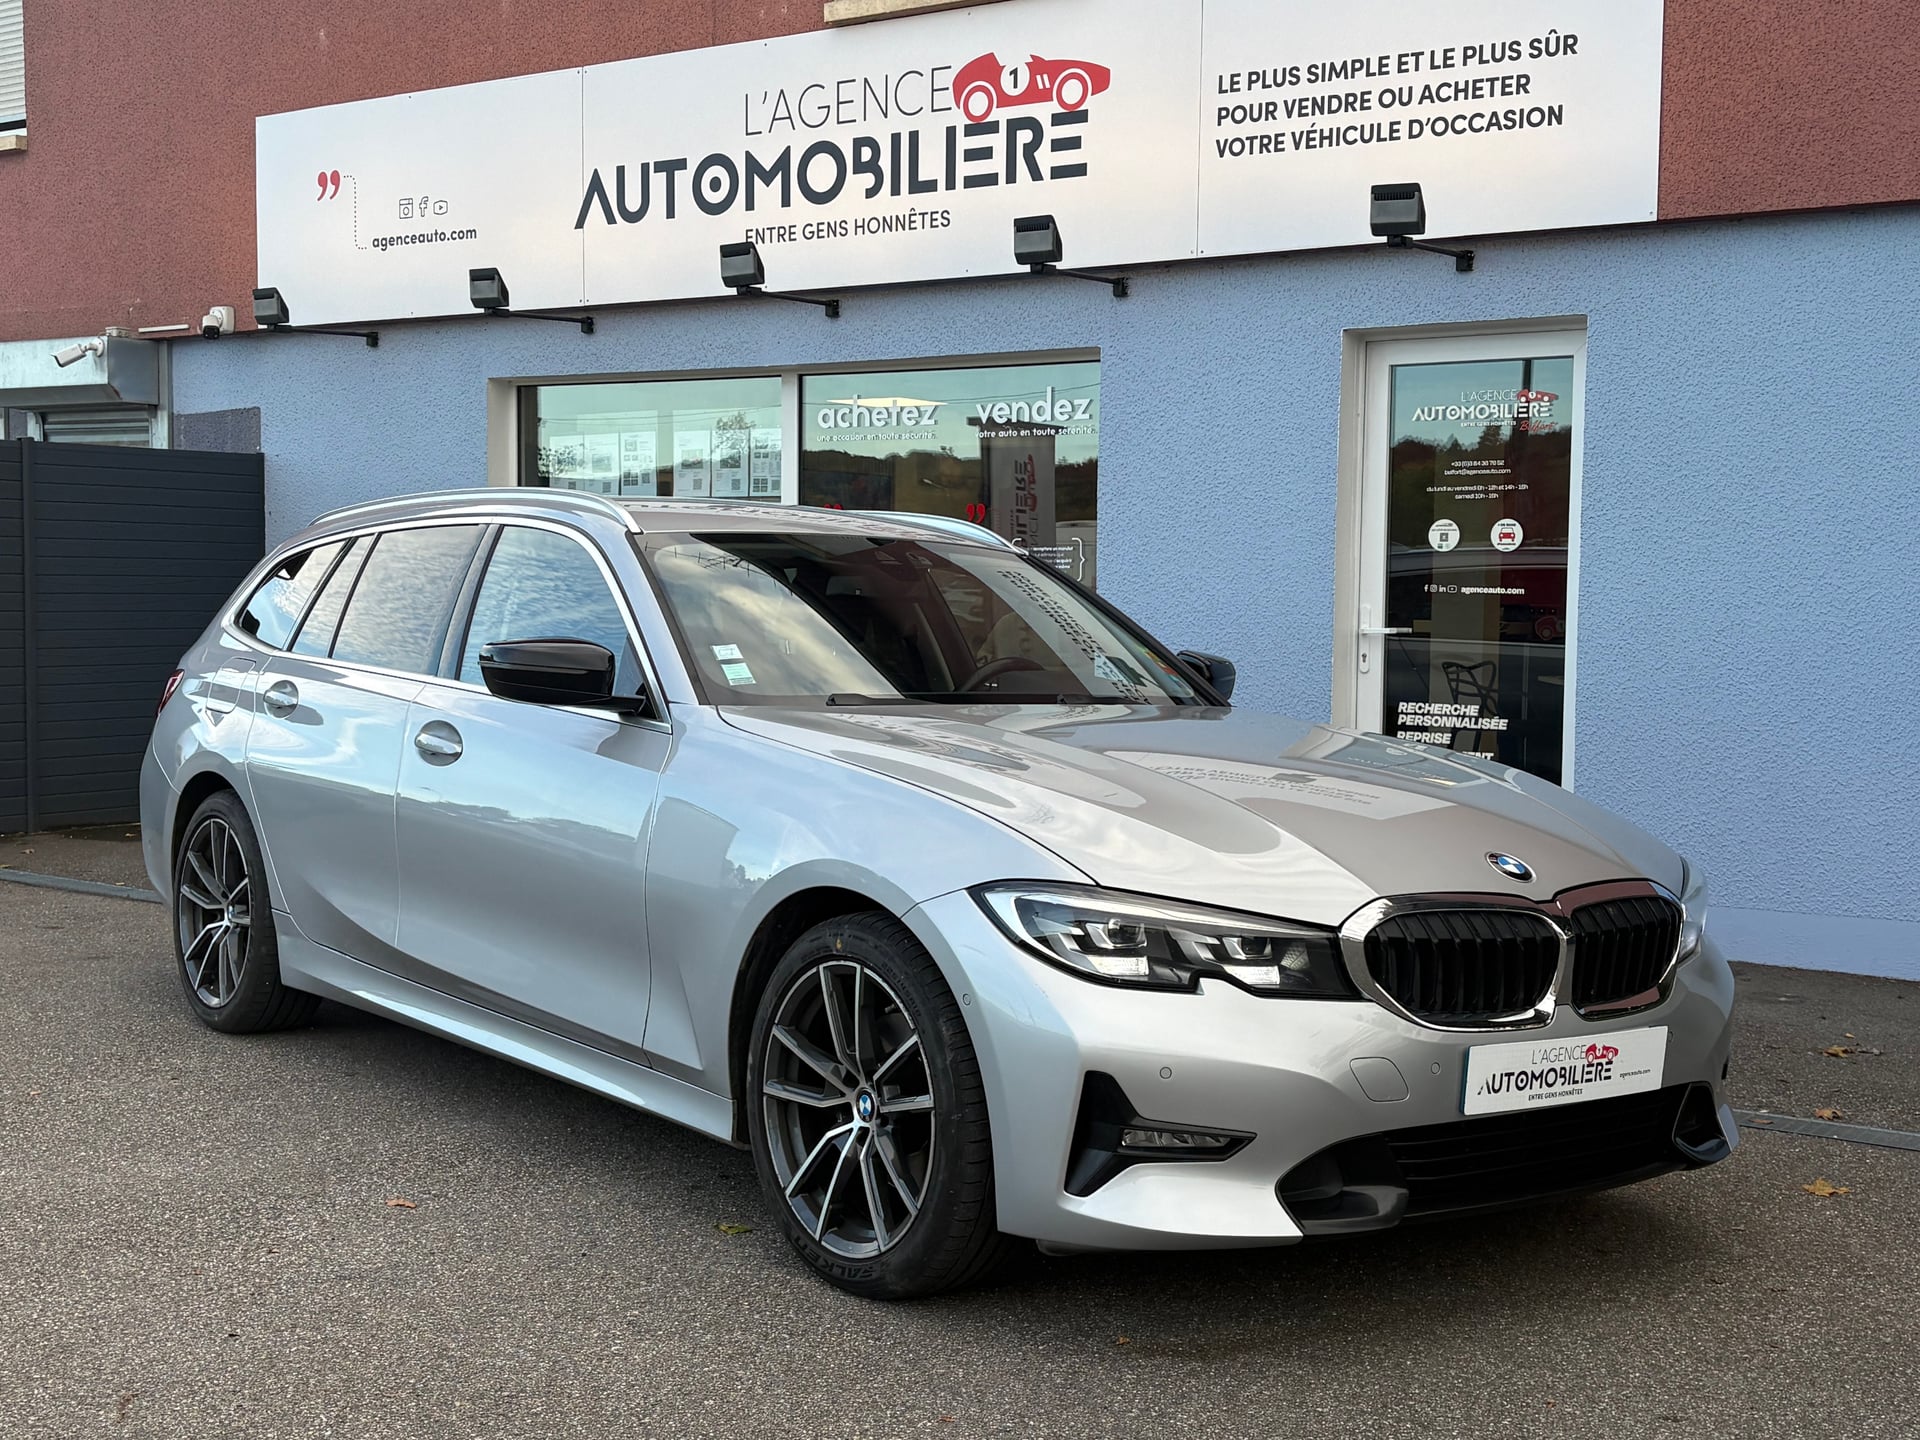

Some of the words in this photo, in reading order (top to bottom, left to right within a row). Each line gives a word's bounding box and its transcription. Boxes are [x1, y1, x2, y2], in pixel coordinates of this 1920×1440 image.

[1217, 73, 1241, 95] LE
[1247, 66, 1301, 91] PLUS
[1306, 55, 1390, 86] SIMPLE
[1397, 51, 1425, 75] ET
[1429, 48, 1456, 71] LE
[1462, 40, 1522, 66] PLUS
[1528, 28, 1580, 60] SÛR
[745, 65, 953, 137] L'AGENCE
[1216, 101, 1278, 127] POUR
[1283, 90, 1372, 120] VENDRE
[1377, 85, 1414, 110] OU
[1417, 73, 1531, 106] ACHETER
[1215, 133, 1286, 159] VOTRE
[1291, 120, 1401, 152] VÉHICULE
[1407, 104, 1564, 140] D'OCCASION
[371, 226, 478, 252] agenceauto.com
[745, 225, 797, 247] ENTRE
[802, 219, 849, 241] GENS
[853, 207, 951, 237] HONNÊTES
[976, 386, 1092, 424] vendez
[1460, 389, 1518, 402] L'AGENCE
[817, 393, 936, 429] achetez
[998, 428, 1018, 438] auto
[1020, 428, 1031, 437] en
[1032, 426, 1056, 436] toute
[1461, 586, 1525, 595] agenceauto.com
[1398, 701, 1479, 716] RECHERCHE
[1397, 714, 1509, 731] PERSONNALISÉE
[1531, 1044, 1587, 1065] L'AGENCE
[1528, 1092, 1544, 1101] ENTRE
[1544, 1090, 1558, 1100] GENS
